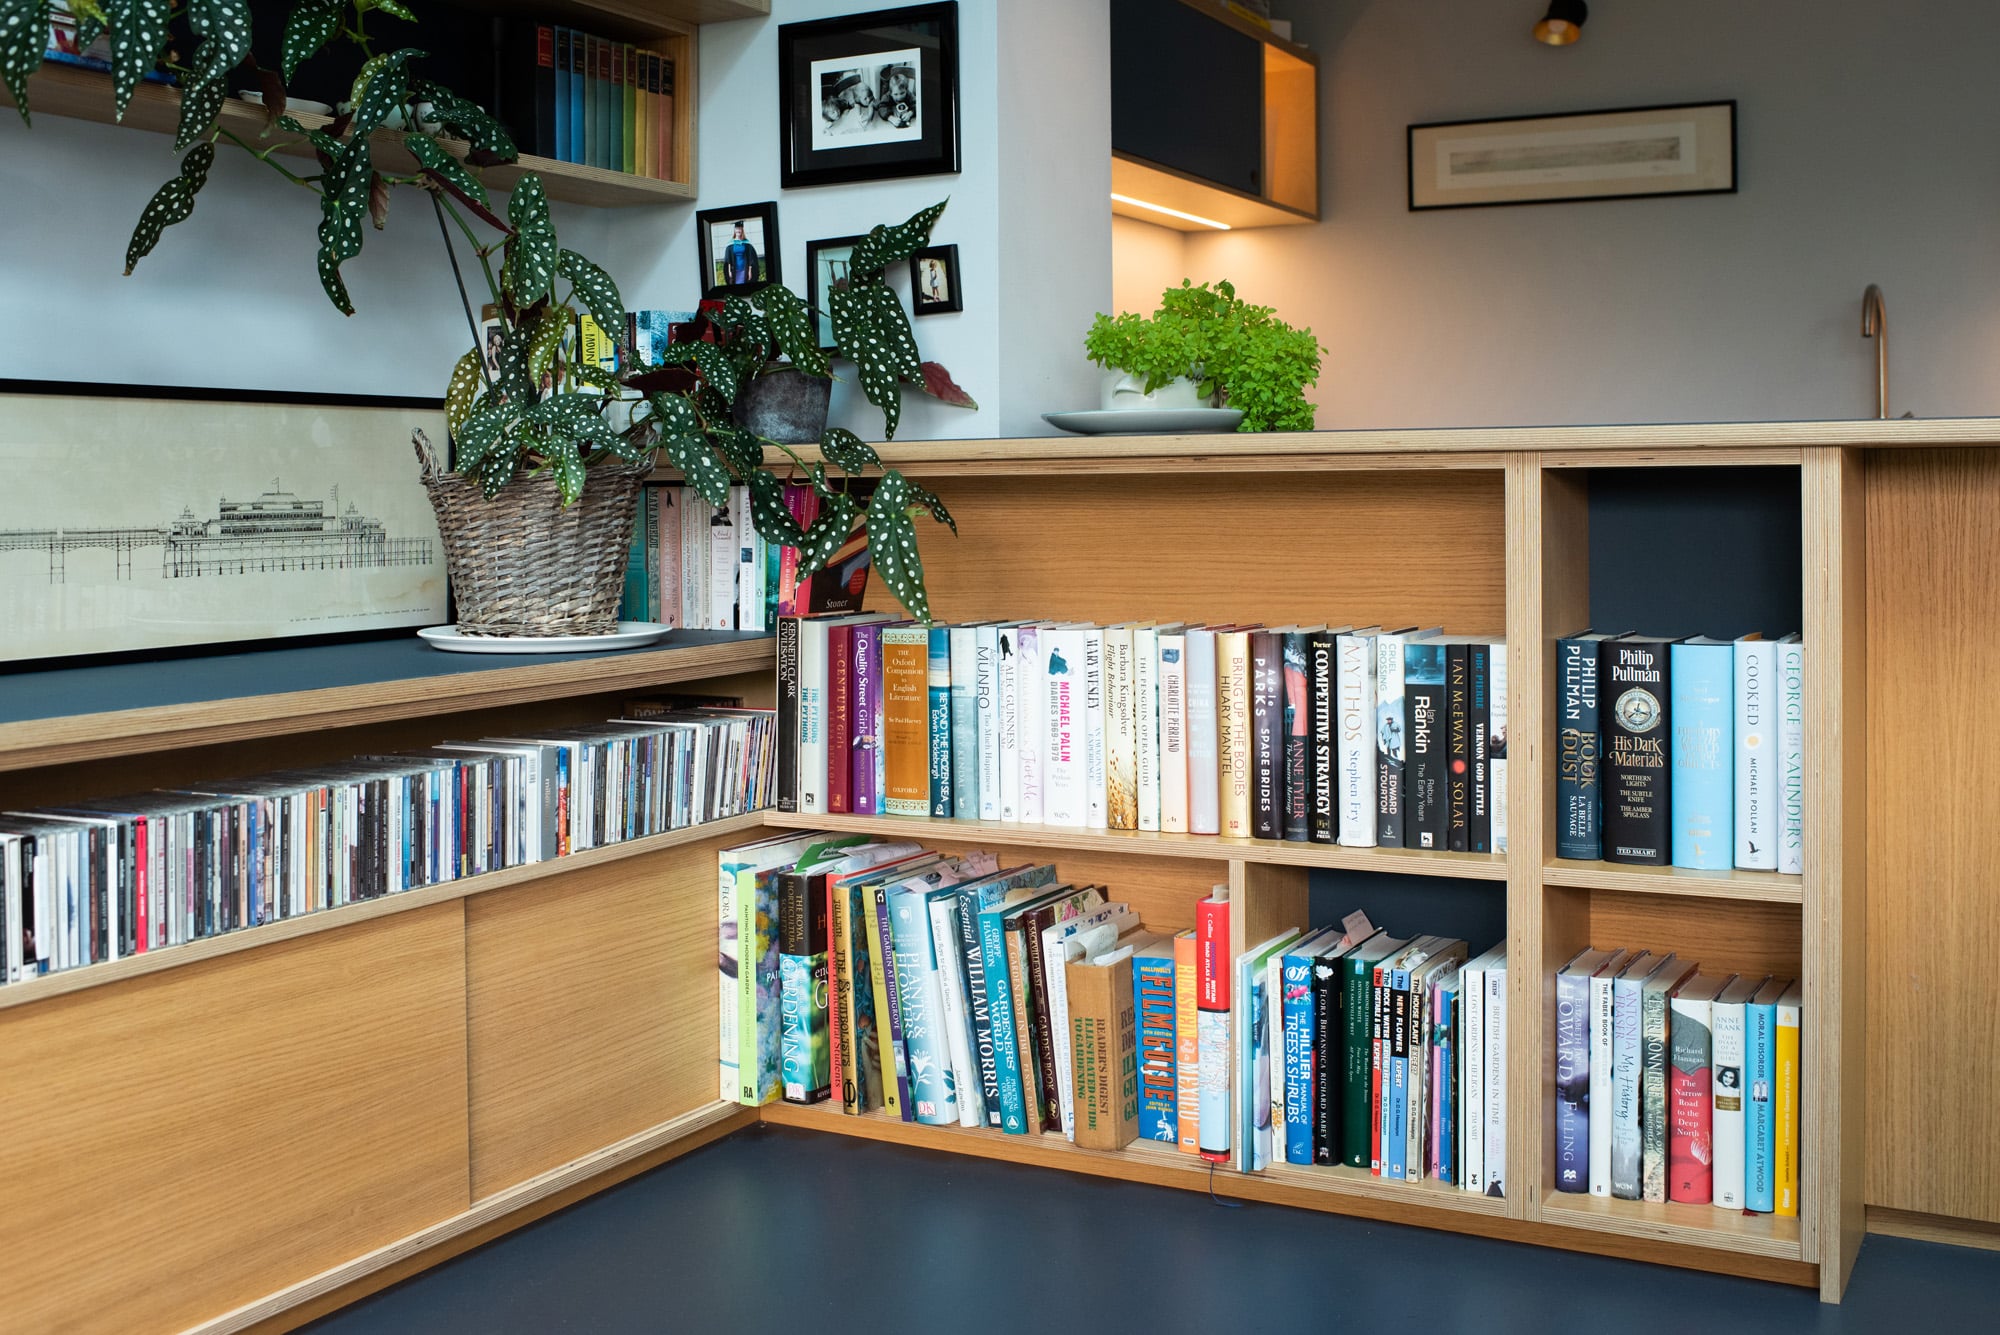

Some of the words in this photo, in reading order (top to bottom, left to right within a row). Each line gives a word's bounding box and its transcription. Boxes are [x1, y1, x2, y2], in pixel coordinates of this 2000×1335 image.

[649, 491, 658, 512] MAYA
[649, 513, 658, 549] ANGELOU
[825, 598, 848, 608] Stoner
[779, 621, 788, 681] CIVILISATION
[787, 622, 796, 667] KENNETH
[855, 639, 869, 677] Quality
[1086, 639, 1099, 669] MARY
[1119, 643, 1128, 682] Barbara
[1620, 650, 1654, 666] Philip
[787, 667, 796, 697] CLARK
[836, 659, 846, 722] CENTURY
[978, 646, 990, 709] MUNRO
[1087, 670, 1099, 711] WESLEY
[1232, 657, 1244, 697] BRING
[1255, 658, 1266, 717] PARKS
[1453, 658, 1463, 686] IAN
[1566, 644, 1581, 721] PULLMAN
[1582, 656, 1596, 709] PHILIP
[1613, 665, 1660, 683] Pullman
[1746, 654, 1759, 726] COOKED
[1786, 652, 1800, 725] GEORGE
[858, 677, 868, 706] Street
[1050, 681, 1059, 716] DIARIES
[1059, 681, 1070, 728] MICHAEL
[1167, 674, 1180, 716] CHARLOTTE
[1220, 675, 1231, 721] HILARY
[1233, 701, 1244, 718] UP
[1315, 650, 1330, 744] COMPETITIVE
[1343, 644, 1362, 742] MYTHOS
[858, 709, 868, 734] Girls
[932, 709, 940, 733] Edwin
[939, 692, 949, 730] BEYOND
[1117, 684, 1129, 737] Kingsolver
[1414, 695, 1431, 754] Rankin
[1426, 709, 1435, 724] Ian
[1452, 691, 1464, 755] McEWAN
[836, 723, 844, 749] Girls
[940, 730, 949, 748] THE
[1050, 718, 1059, 762] 1969-1979
[1059, 731, 1071, 762] PALIN
[1168, 717, 1180, 753] PERRIAND
[1221, 725, 1232, 777] MANTEL
[1233, 721, 1245, 747] THE
[1475, 722, 1485, 760] VERNON
[1613, 735, 1634, 752] His
[1634, 736, 1664, 753] Dark
[931, 733, 940, 779] Mickleburgh
[940, 749, 949, 785] FROZEN
[1234, 751, 1245, 797] BODIES
[1293, 738, 1304, 777] ANNE
[1345, 750, 1360, 798] Stephen
[1475, 761, 1485, 782] GOD
[1609, 751, 1664, 768] Materials
[940, 785, 950, 802] SEA
[1315, 745, 1330, 816] STRATEGY
[1380, 763, 1388, 815] STOURTON
[1389, 774, 1398, 815] EDWARD
[1631, 790, 1653, 798] SUBTLE
[1749, 757, 1757, 796] MICHAEL
[1293, 780, 1305, 820] TYLER
[1346, 800, 1361, 823] Fry
[1452, 781, 1464, 829] SOLAR
[1476, 783, 1485, 816] LITTLE
[1569, 795, 1577, 837] SAUVAGE
[1578, 796, 1586, 808] LA
[1750, 799, 1758, 834] POLLAN
[1786, 752, 1801, 849] SAUNDERS
[1578, 809, 1586, 838] BELLE
[723, 885, 731, 919] FLORA
[959, 895, 976, 943] Essential
[882, 934, 893, 967] GARDEN
[887, 968, 895, 980] AT
[906, 952, 925, 1021] PLANTS
[966, 945, 990, 1021] WILLIAM
[1010, 951, 1021, 991] GARDEN
[888, 981, 900, 1030] HIGHGROVE
[895, 952, 916, 1039] FLOWERS
[1015, 993, 1024, 1016] LOST
[1140, 974, 1173, 1031] FILM
[1319, 988, 1328, 1016] FLORA
[781, 958, 800, 1073] GARDENING
[913, 1025, 927, 1039] &
[990, 1000, 1004, 1052] WORLD
[1017, 1020, 1025, 1030] IN
[1286, 1013, 1298, 1053] TREES
[1299, 1010, 1307, 1025] THE
[1492, 1005, 1500, 1040] BRITISH
[1558, 983, 1574, 1081] HOWARD
[1615, 995, 1626, 1040] FRASER
[1625, 987, 1637, 1050] ANTONIA
[1019, 1032, 1028, 1056] TIME
[1096, 1018, 1107, 1073] READER'S
[1319, 1018, 1328, 1069] BRITANNICA
[1395, 1016, 1403, 1053] FLOWER
[1601, 1038, 1608, 1047] OF
[1675, 1045, 1703, 1055] Richard
[978, 1028, 999, 1098] MORRIS
[1084, 1017, 1097, 1094] ILLUSTRATED
[1142, 1036, 1175, 1102] GUIDE
[1287, 1053, 1298, 1065] &
[1299, 1028, 1311, 1080] HILLIER
[1373, 1041, 1381, 1071] EXPERT
[1492, 1042, 1500, 1086] GARDENS
[1673, 1054, 1705, 1064] Flanagan
[1757, 1042, 1765, 1079] DISORDER
[743, 1086, 753, 1099] RA
[1023, 1063, 1033, 1094] PENNY
[1319, 1072, 1328, 1110] RICHARD
[1395, 1059, 1403, 1089] EXPERT
[1680, 1079, 1697, 1087] The
[1027, 1095, 1036, 1124] DAVID
[1098, 1075, 1109, 1116] DIGEST
[1287, 1065, 1299, 1124] SHRUBS
[1299, 1082, 1307, 1112] MANUAL
[1492, 1088, 1500, 1100] IN
[1674, 1089, 1703, 1098] Narrow
[1678, 1098, 1699, 1107] Road
[1087, 1095, 1097, 1131] GUIDE
[1300, 1114, 1308, 1125] OF
[1319, 1111, 1328, 1140] MABEY
[1492, 1102, 1500, 1126] TIME
[1563, 1101, 1578, 1162] FALLING
[1677, 1109, 1685, 1117] to
[1686, 1109, 1699, 1117] the
[1678, 1119, 1699, 1129] Deep
[1756, 1103, 1766, 1152] MARGARET
[1676, 1128, 1700, 1138] North
[1756, 1153, 1765, 1194] ATWOOD
